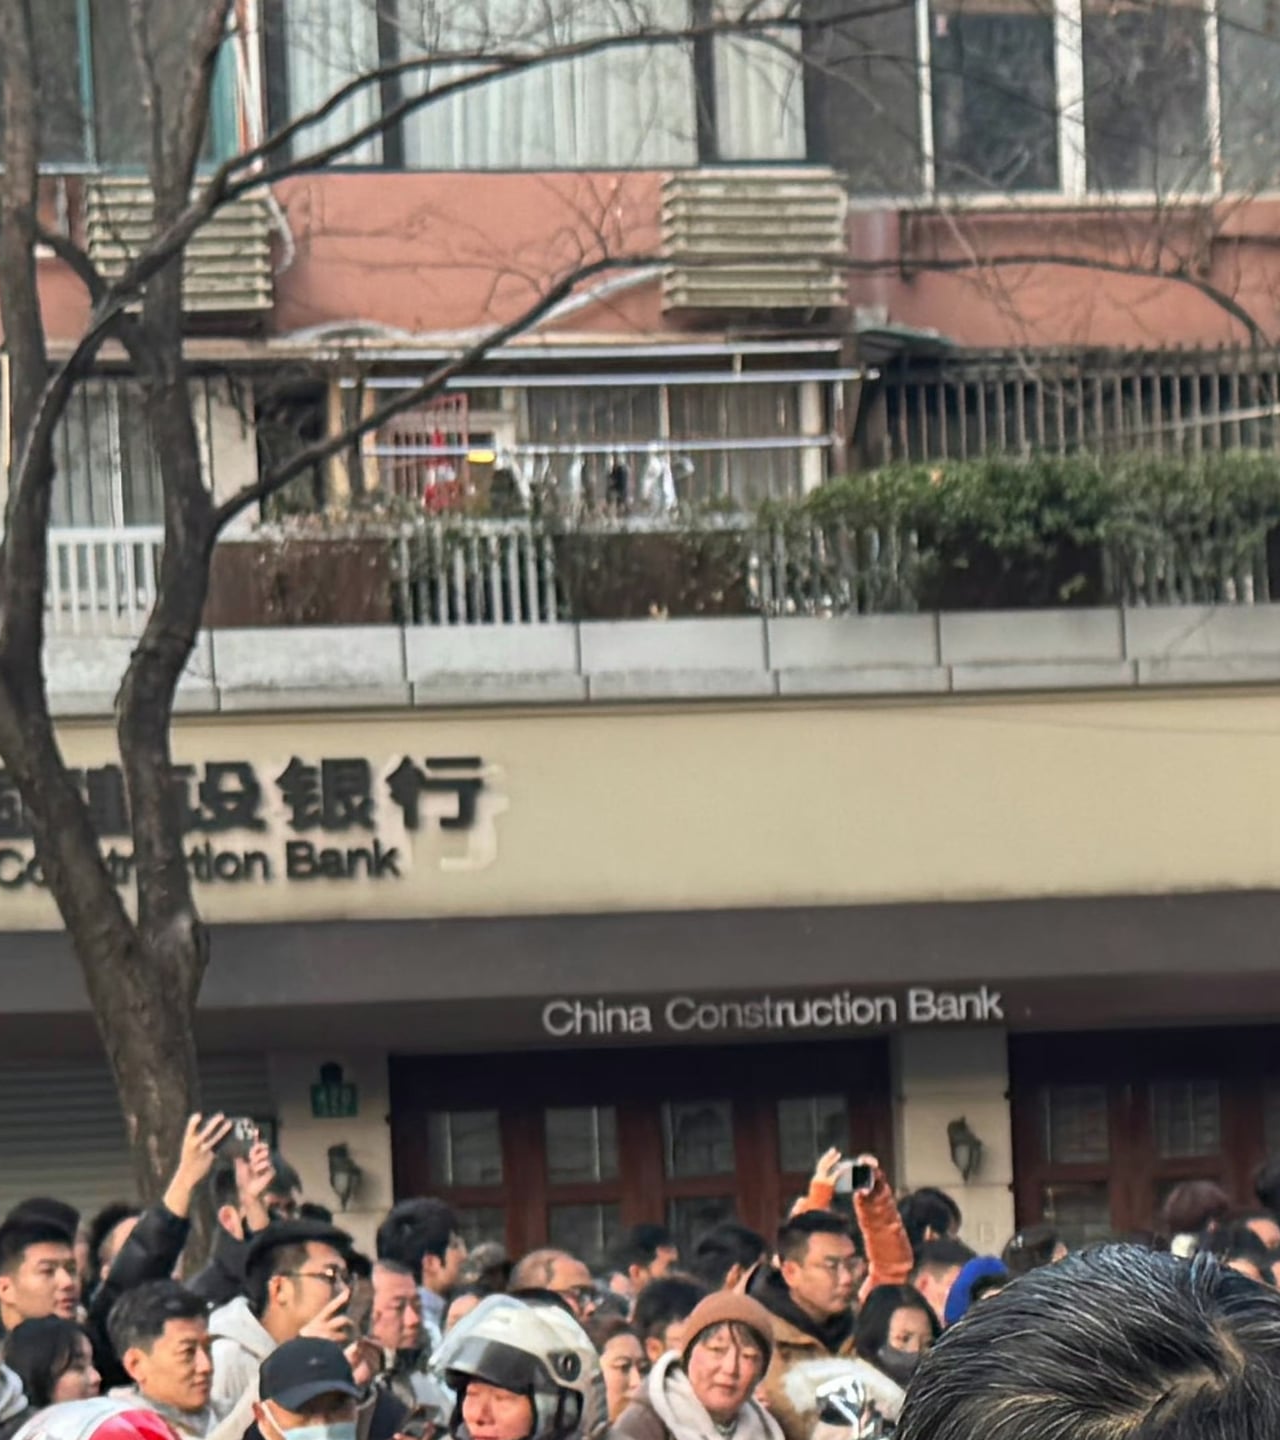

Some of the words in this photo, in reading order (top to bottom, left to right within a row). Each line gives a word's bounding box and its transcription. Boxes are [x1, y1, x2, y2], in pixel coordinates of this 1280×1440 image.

[285, 838, 401, 880] Bank
[541, 1000, 653, 1037] China
[665, 991, 897, 1031] Construction
[907, 985, 1005, 1024] Bank
